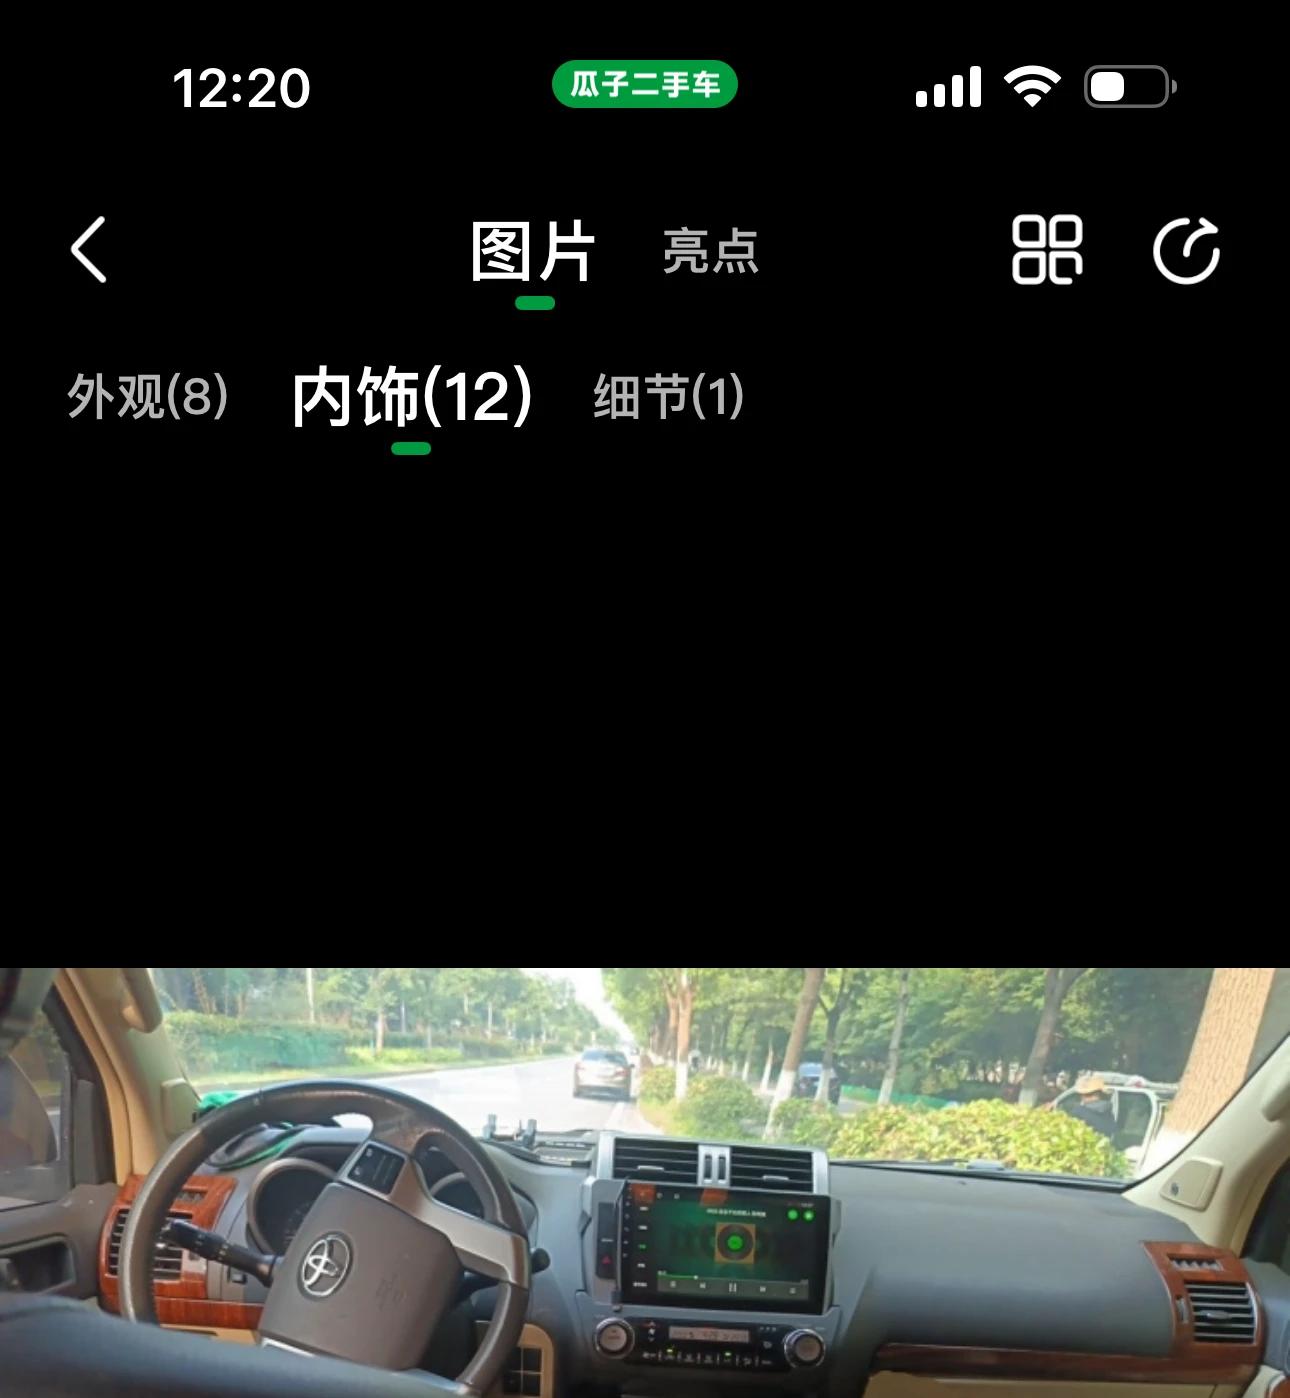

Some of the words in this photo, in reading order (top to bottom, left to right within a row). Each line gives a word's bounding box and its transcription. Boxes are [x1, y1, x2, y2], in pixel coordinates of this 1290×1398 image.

[173, 67, 311, 109] 12:20
[570, 70, 721, 98] 瓜子二手车
[472, 218, 595, 282] 图片
[663, 226, 759, 274] 亮点
[67, 372, 228, 421] 外观(8)
[294, 364, 531, 428] 内饰(12)
[593, 372, 744, 420] 细节(1)
